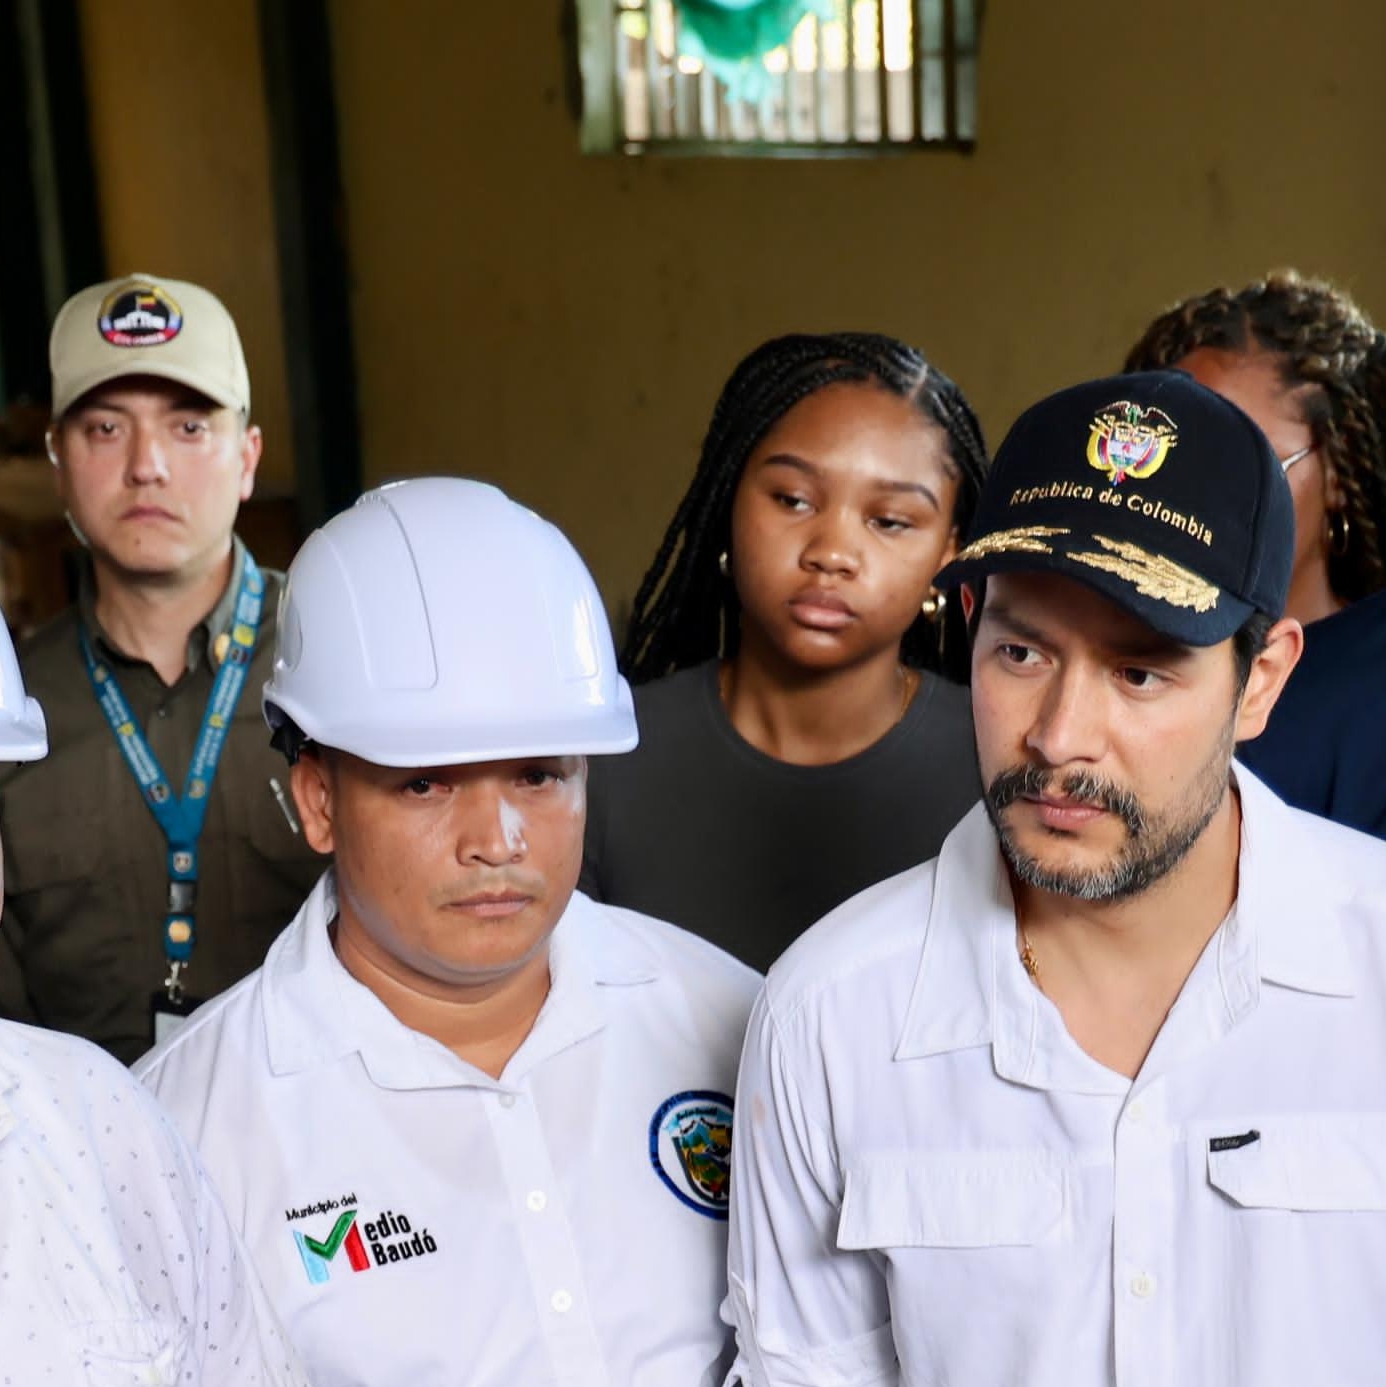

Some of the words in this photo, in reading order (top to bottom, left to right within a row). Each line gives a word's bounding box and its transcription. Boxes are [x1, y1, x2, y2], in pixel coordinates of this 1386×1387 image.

[1099, 488, 1123, 507] de
[1127, 494, 1213, 547] Colombia
[285, 1199, 340, 1222] Municipio
[340, 1192, 358, 1208] del
[371, 1228, 438, 1267] Baudó
